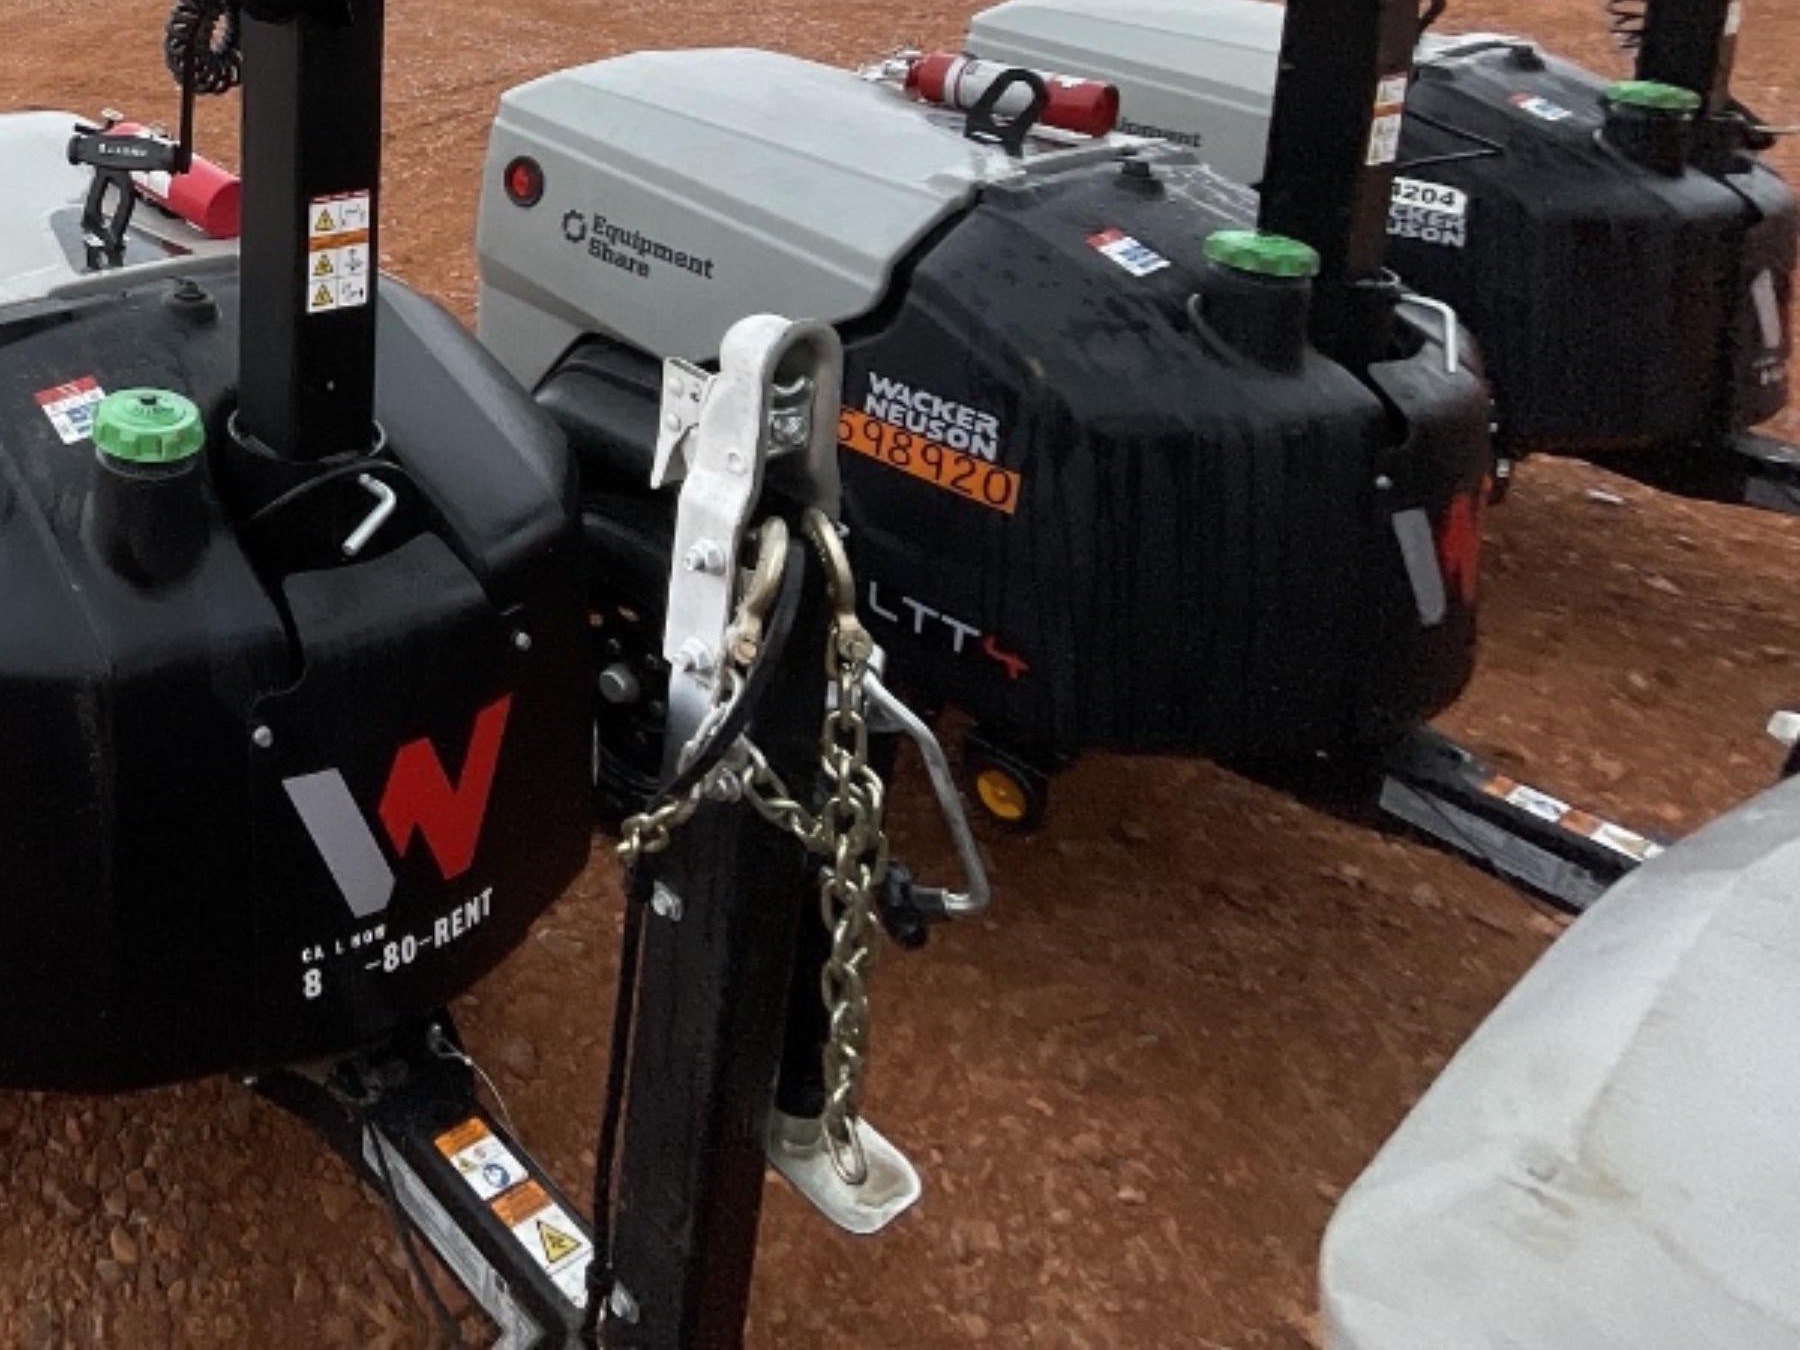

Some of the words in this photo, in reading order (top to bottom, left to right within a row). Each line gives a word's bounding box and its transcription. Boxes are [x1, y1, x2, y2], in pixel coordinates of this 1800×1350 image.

[588, 237, 649, 278] Share
[592, 213, 714, 280] Equipment
[864, 393, 998, 461] NEUSON
[869, 371, 999, 439] WACKER
[869, 581, 1030, 679] LTT4
[302, 939, 344, 964] CAL
